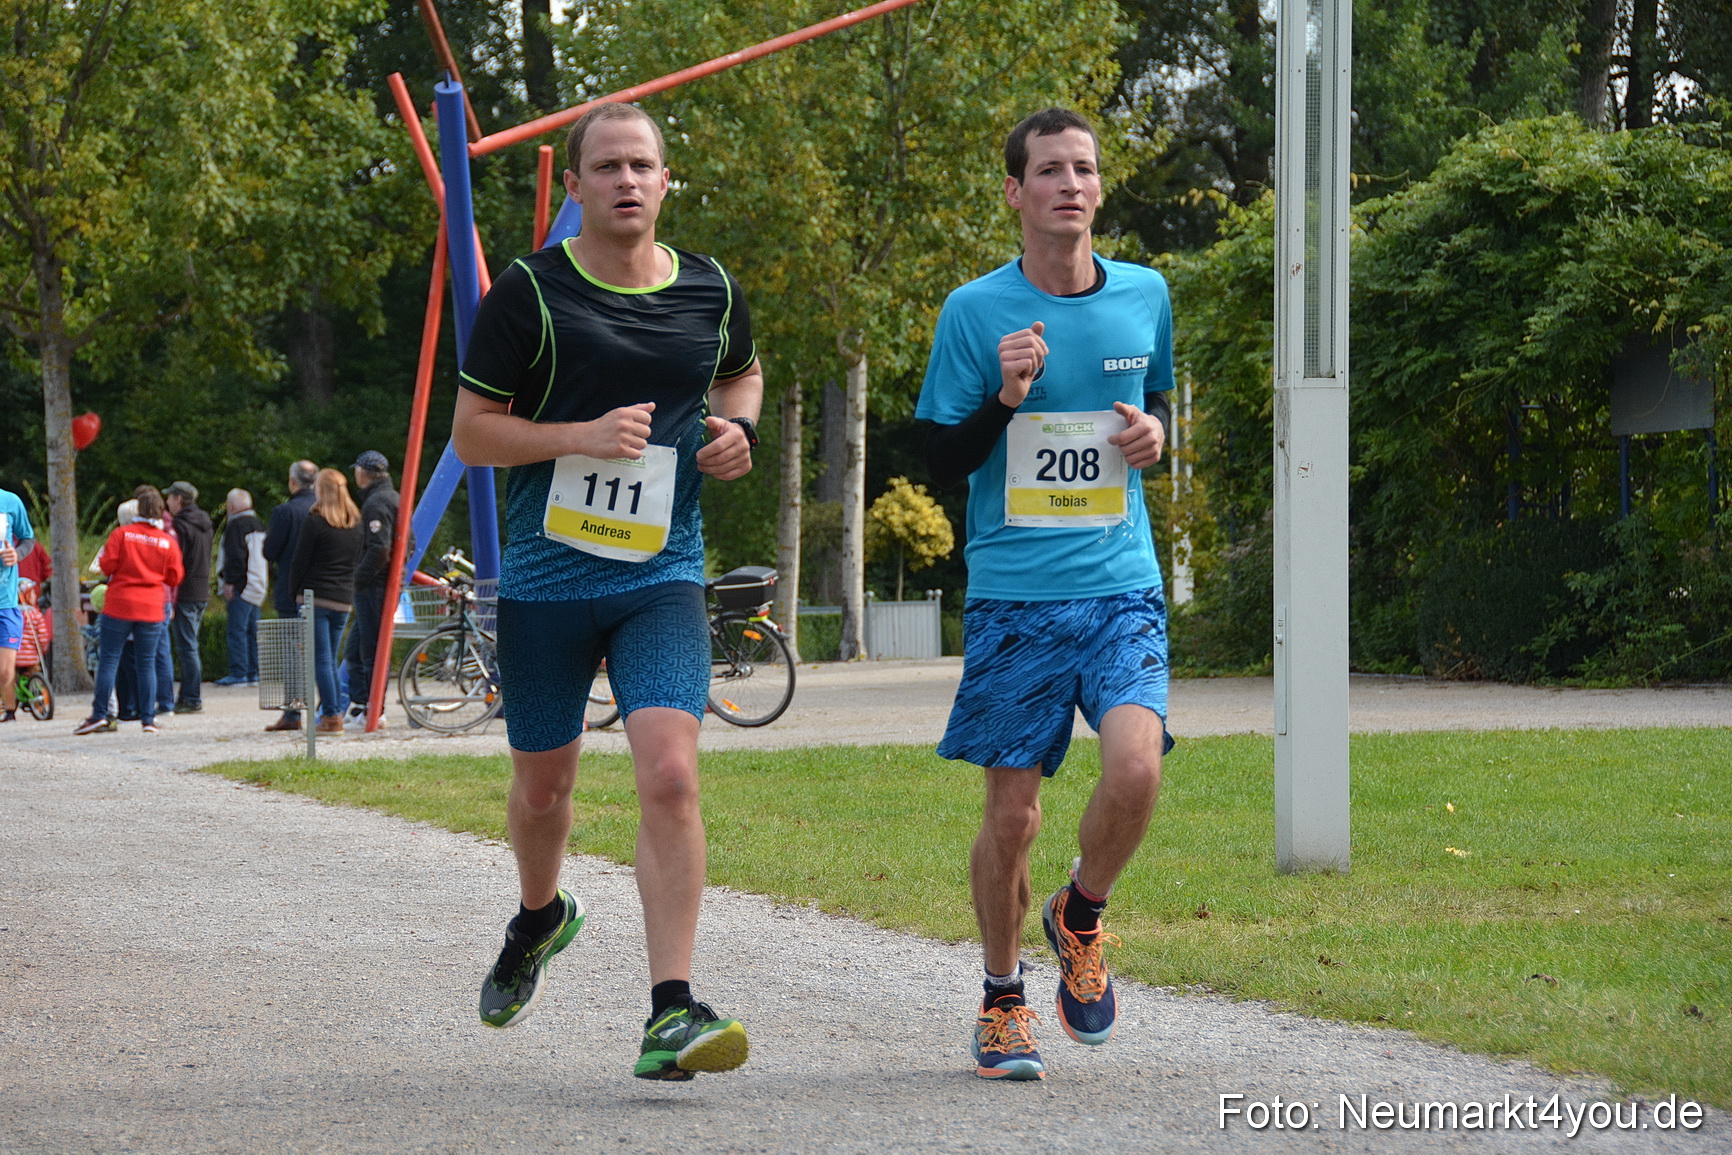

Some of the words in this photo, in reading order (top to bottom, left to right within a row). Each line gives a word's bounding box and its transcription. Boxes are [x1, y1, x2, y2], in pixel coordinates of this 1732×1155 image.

[1103, 356, 1150, 371] BOCK
[1054, 422, 1094, 433] BOCK
[1036, 447, 1100, 483] 208
[583, 472, 643, 515] 111
[1048, 494, 1088, 507] Tobias
[580, 519, 632, 540] Andreas
